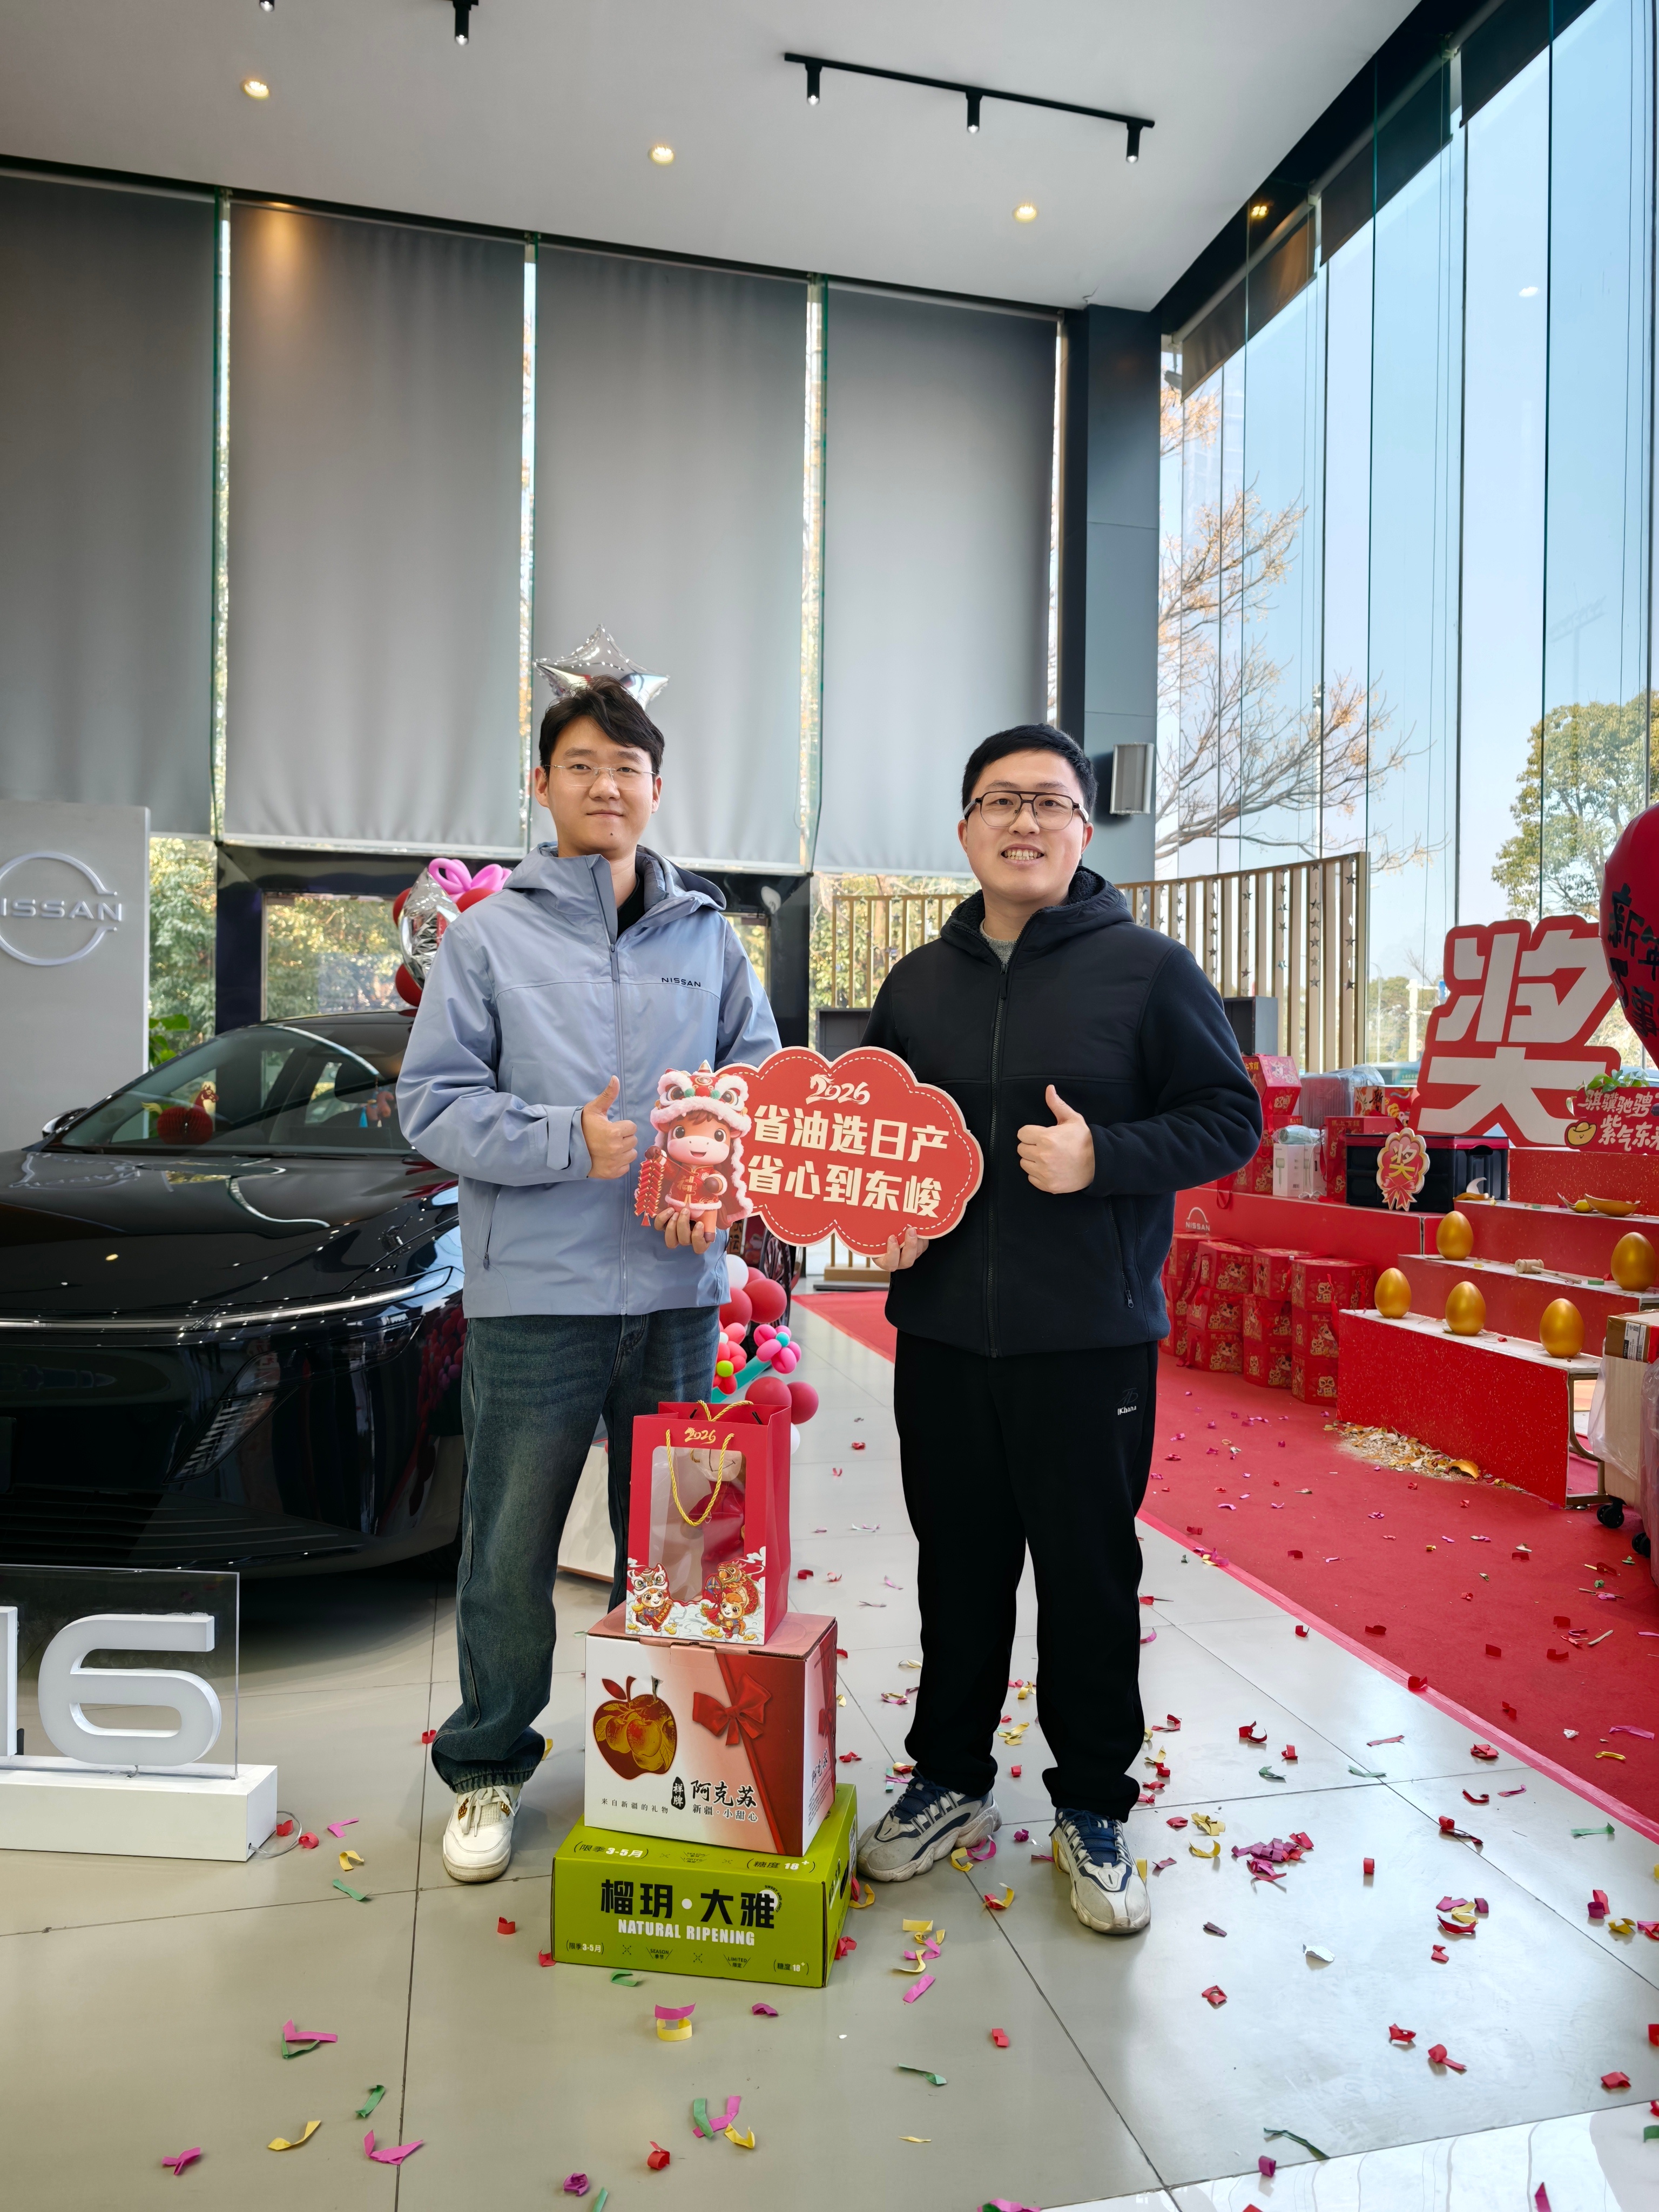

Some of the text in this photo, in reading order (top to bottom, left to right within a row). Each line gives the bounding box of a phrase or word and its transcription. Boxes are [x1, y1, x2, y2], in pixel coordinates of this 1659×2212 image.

[1, 898, 123, 921] ISSAN
[662, 977, 701, 987] NISSAN
[1418, 929, 1614, 1147] 奖
[805, 1074, 871, 1105] 2026
[1577, 1089, 1659, 1118] 骐骥驰骋
[753, 1104, 949, 1163] 省油选日产
[1388, 1143, 1418, 1180] 奖
[747, 1155, 942, 1218] 省心到东峻
[1185, 1221, 1210, 1231] NISSAN
[684, 1427, 716, 1445] 2026
[601, 1798, 669, 1813] 来自新疆的礼物
[672, 1783, 684, 1808] 祥牌
[691, 1780, 757, 1809] 阿克苏
[601, 1879, 774, 1928] 榴玥·大雅
[618, 1919, 755, 1946] NATURAL RIPENING
